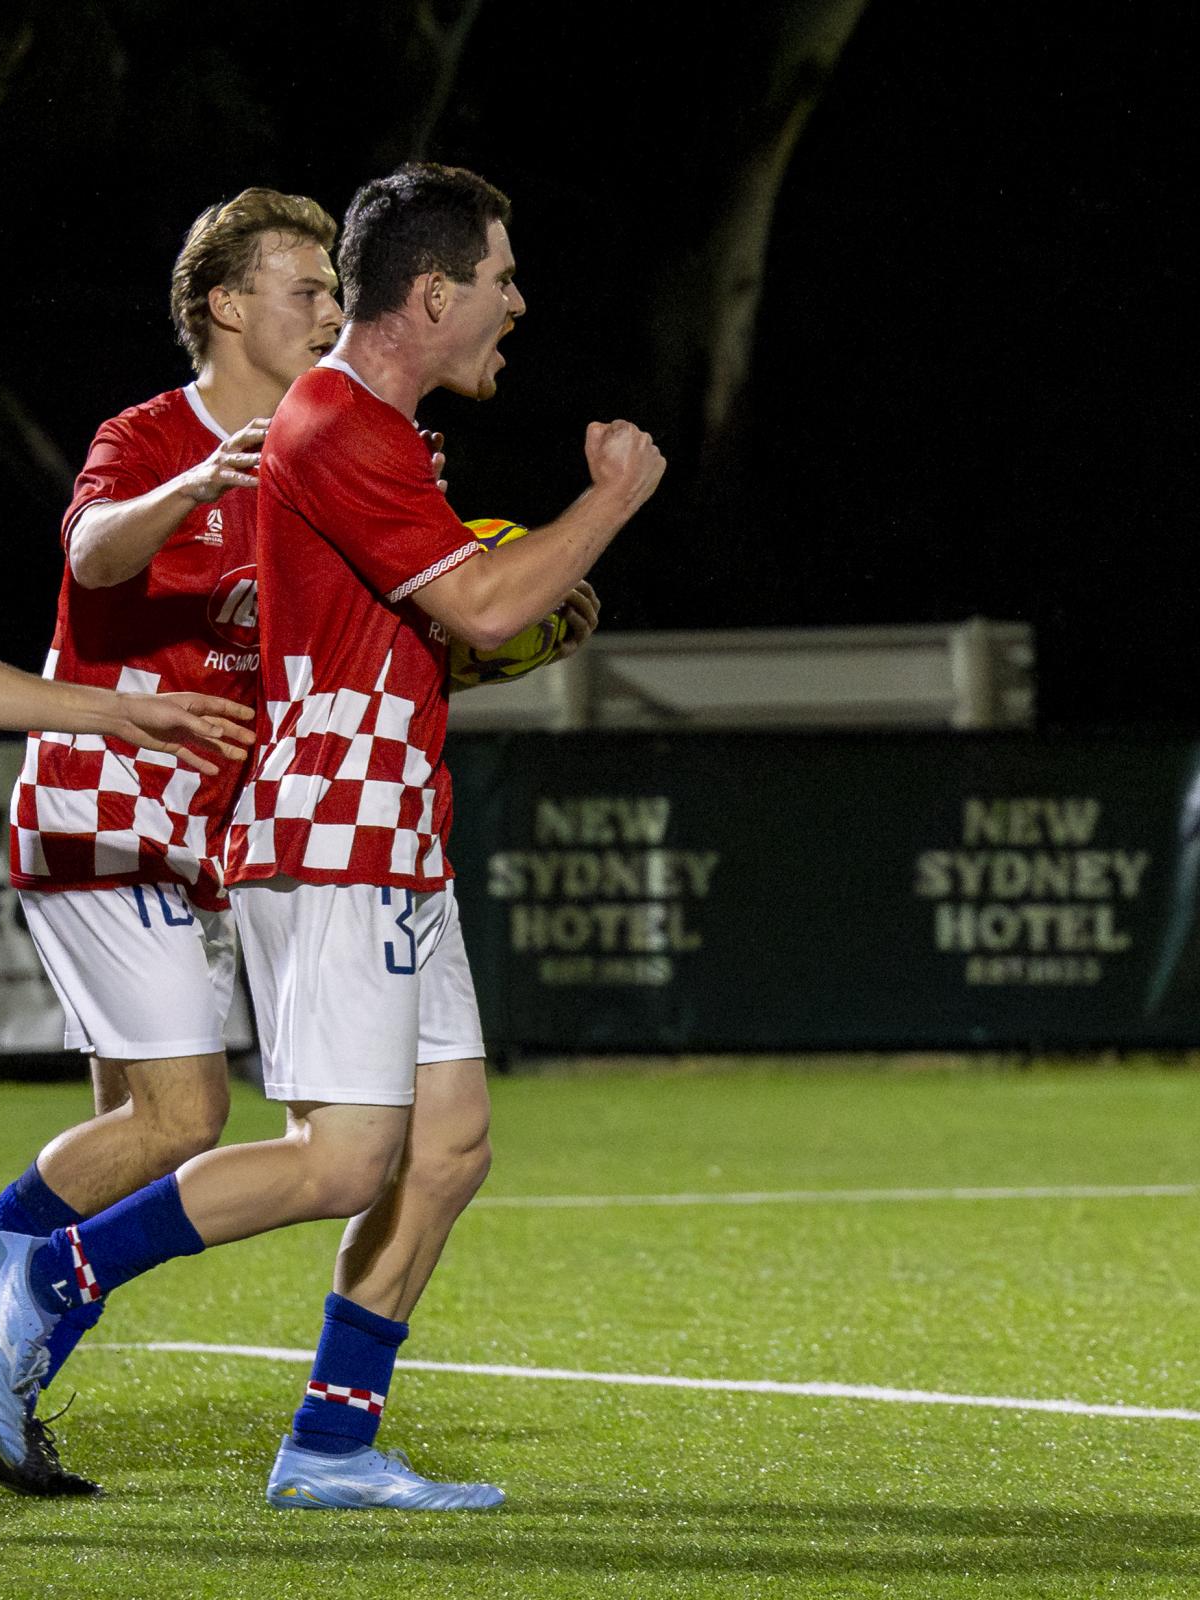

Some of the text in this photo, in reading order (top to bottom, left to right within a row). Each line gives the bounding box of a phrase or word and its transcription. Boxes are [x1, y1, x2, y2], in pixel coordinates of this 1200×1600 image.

[215, 578, 258, 628] IG
[203, 649, 260, 673] RICHMO
[536, 799, 669, 845] NEW
[961, 799, 1099, 846] NEW
[487, 851, 719, 898] SYDNEY
[915, 851, 1150, 898] SYDNEY
[511, 904, 701, 952] HOTEL
[934, 905, 1133, 952] HOTEL
